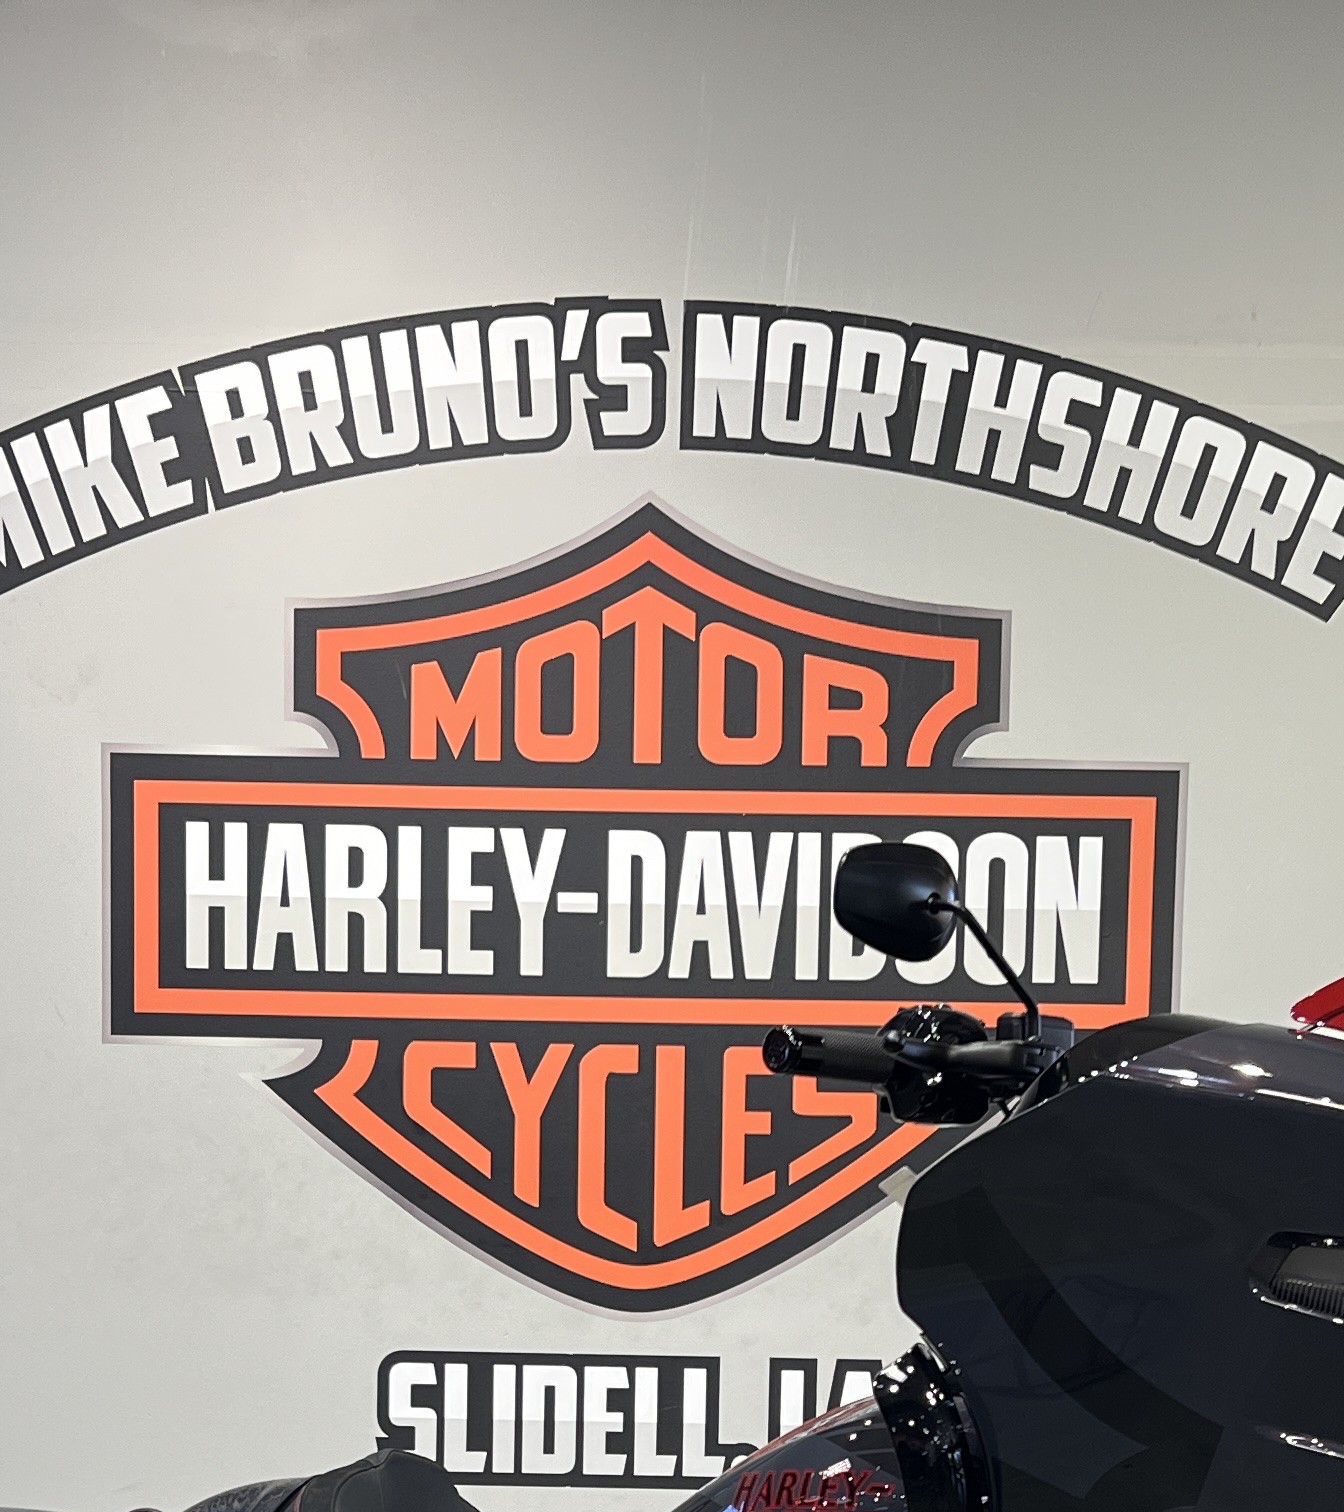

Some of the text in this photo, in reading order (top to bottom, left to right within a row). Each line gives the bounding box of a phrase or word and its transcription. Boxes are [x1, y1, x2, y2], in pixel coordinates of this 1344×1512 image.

[194, 308, 654, 494] BRUNO'S
[409, 584, 890, 767] MOTOR
[402, 1037, 878, 1248] CYCLES
